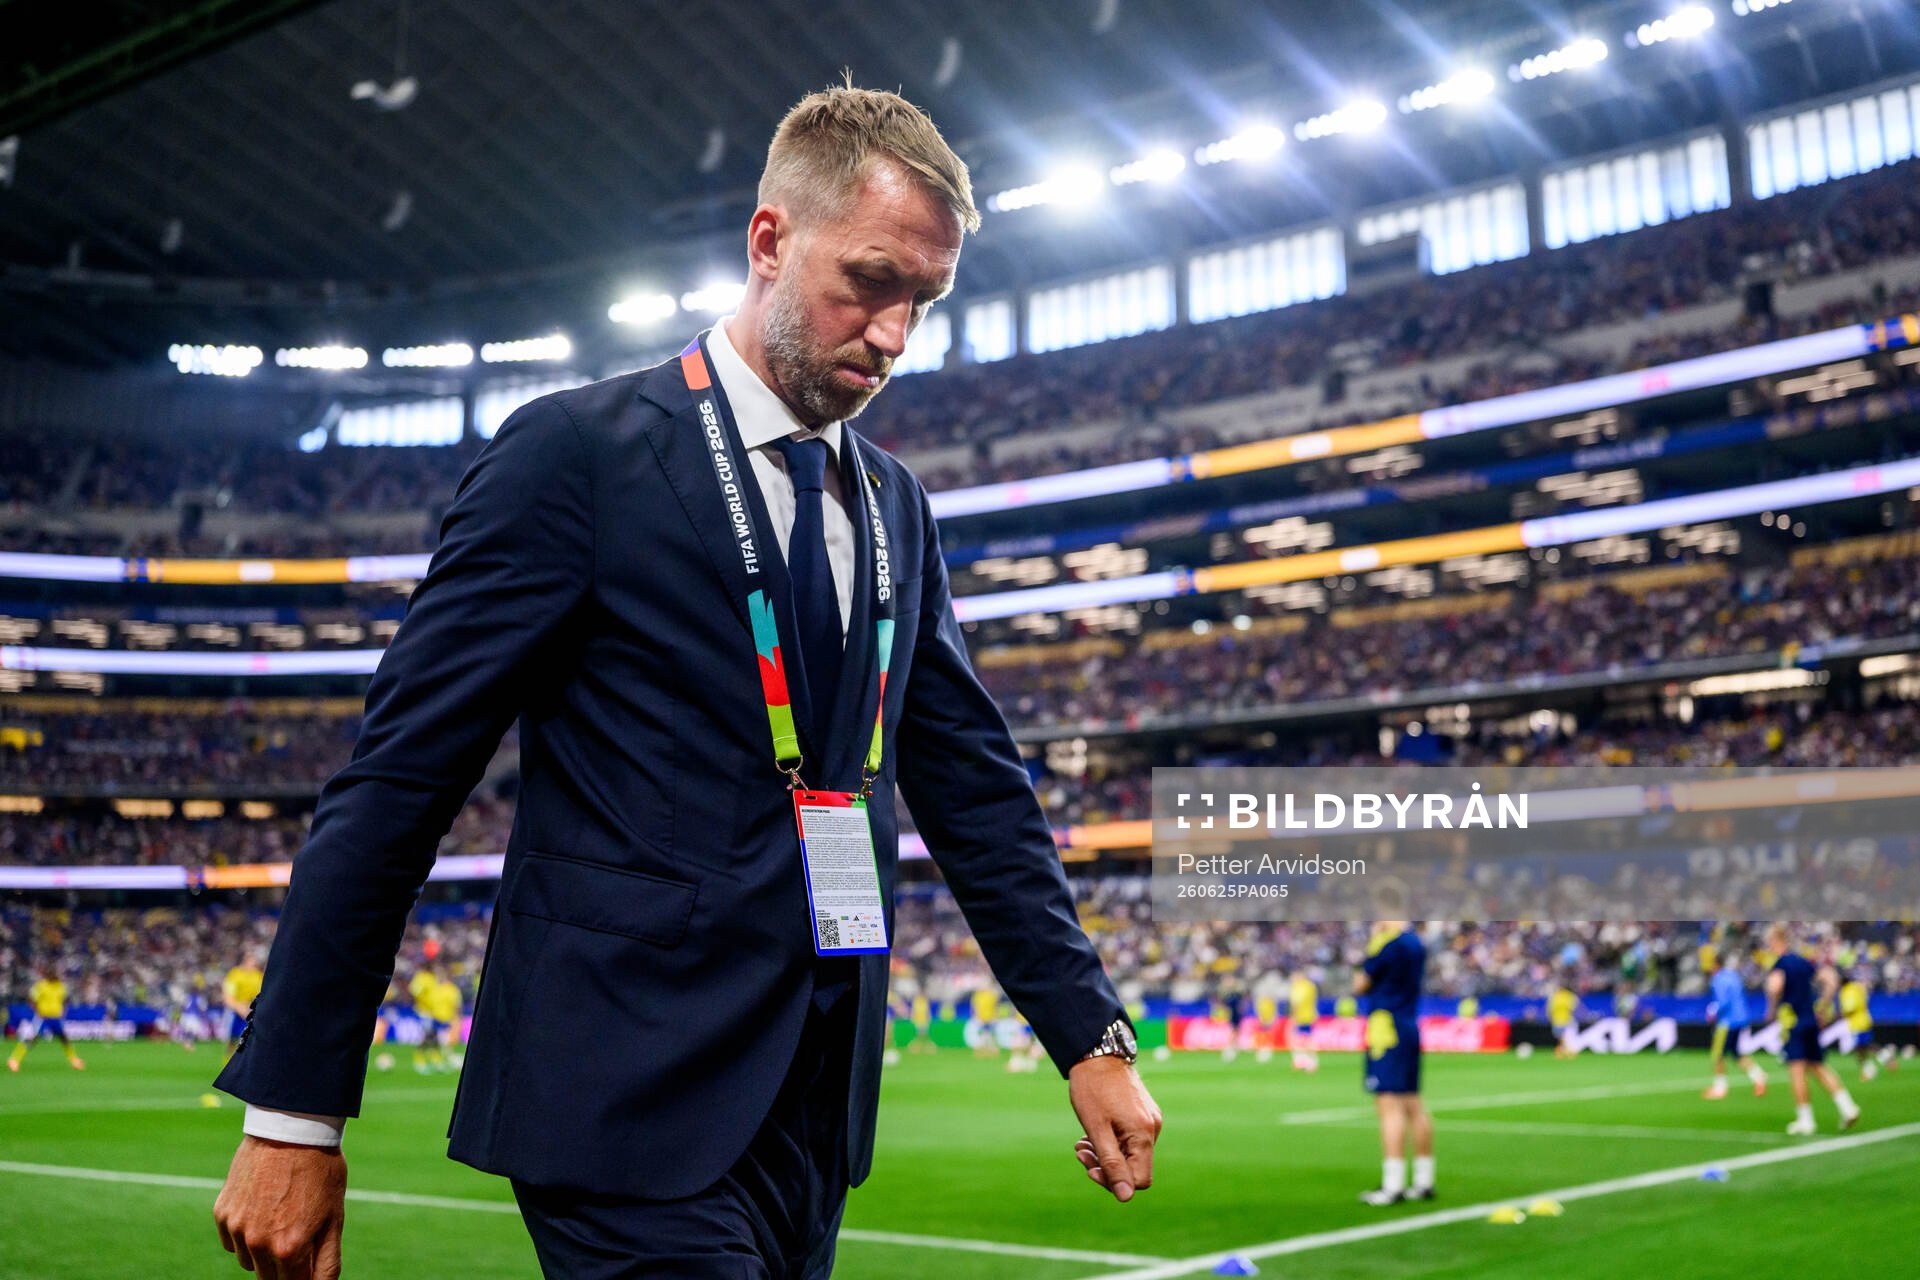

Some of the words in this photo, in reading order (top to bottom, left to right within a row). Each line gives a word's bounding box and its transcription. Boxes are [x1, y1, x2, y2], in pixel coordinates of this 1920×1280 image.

[699, 399, 725, 451] 2026
[714, 454, 734, 482] CUP
[723, 483, 751, 538] WORLD
[873, 518, 886, 547] CUP
[741, 538, 760, 575] FIFA
[876, 548, 891, 602] 2026
